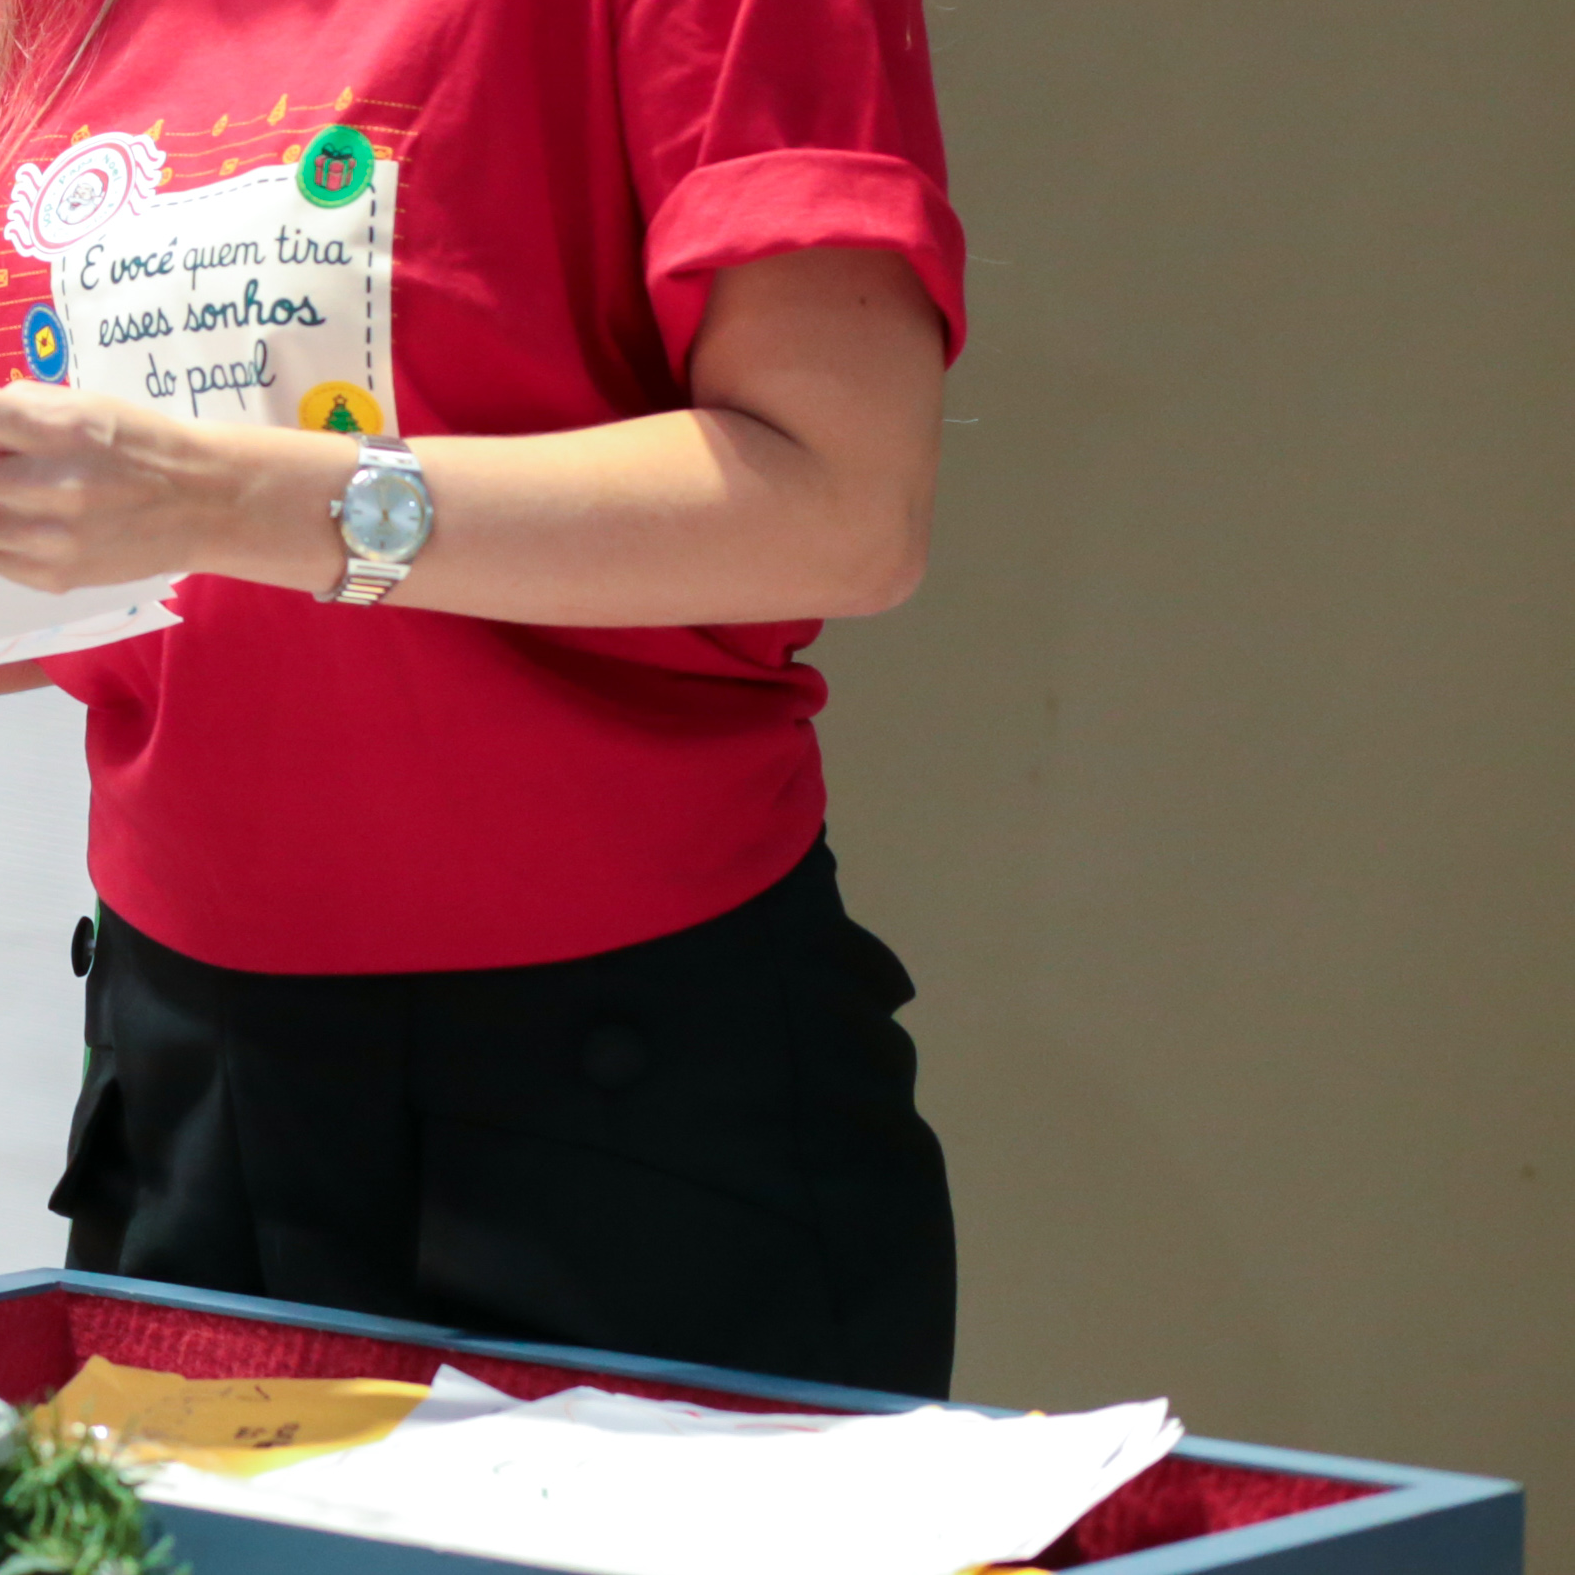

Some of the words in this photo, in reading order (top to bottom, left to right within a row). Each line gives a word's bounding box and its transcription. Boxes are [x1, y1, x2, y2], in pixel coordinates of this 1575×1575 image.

[80, 233, 107, 291] É
[110, 236, 179, 284] você
[183, 237, 266, 291] quem
[275, 224, 353, 267] tira
[98, 308, 174, 348] esses
[183, 278, 327, 333] sonhos
[145, 353, 177, 399] do
